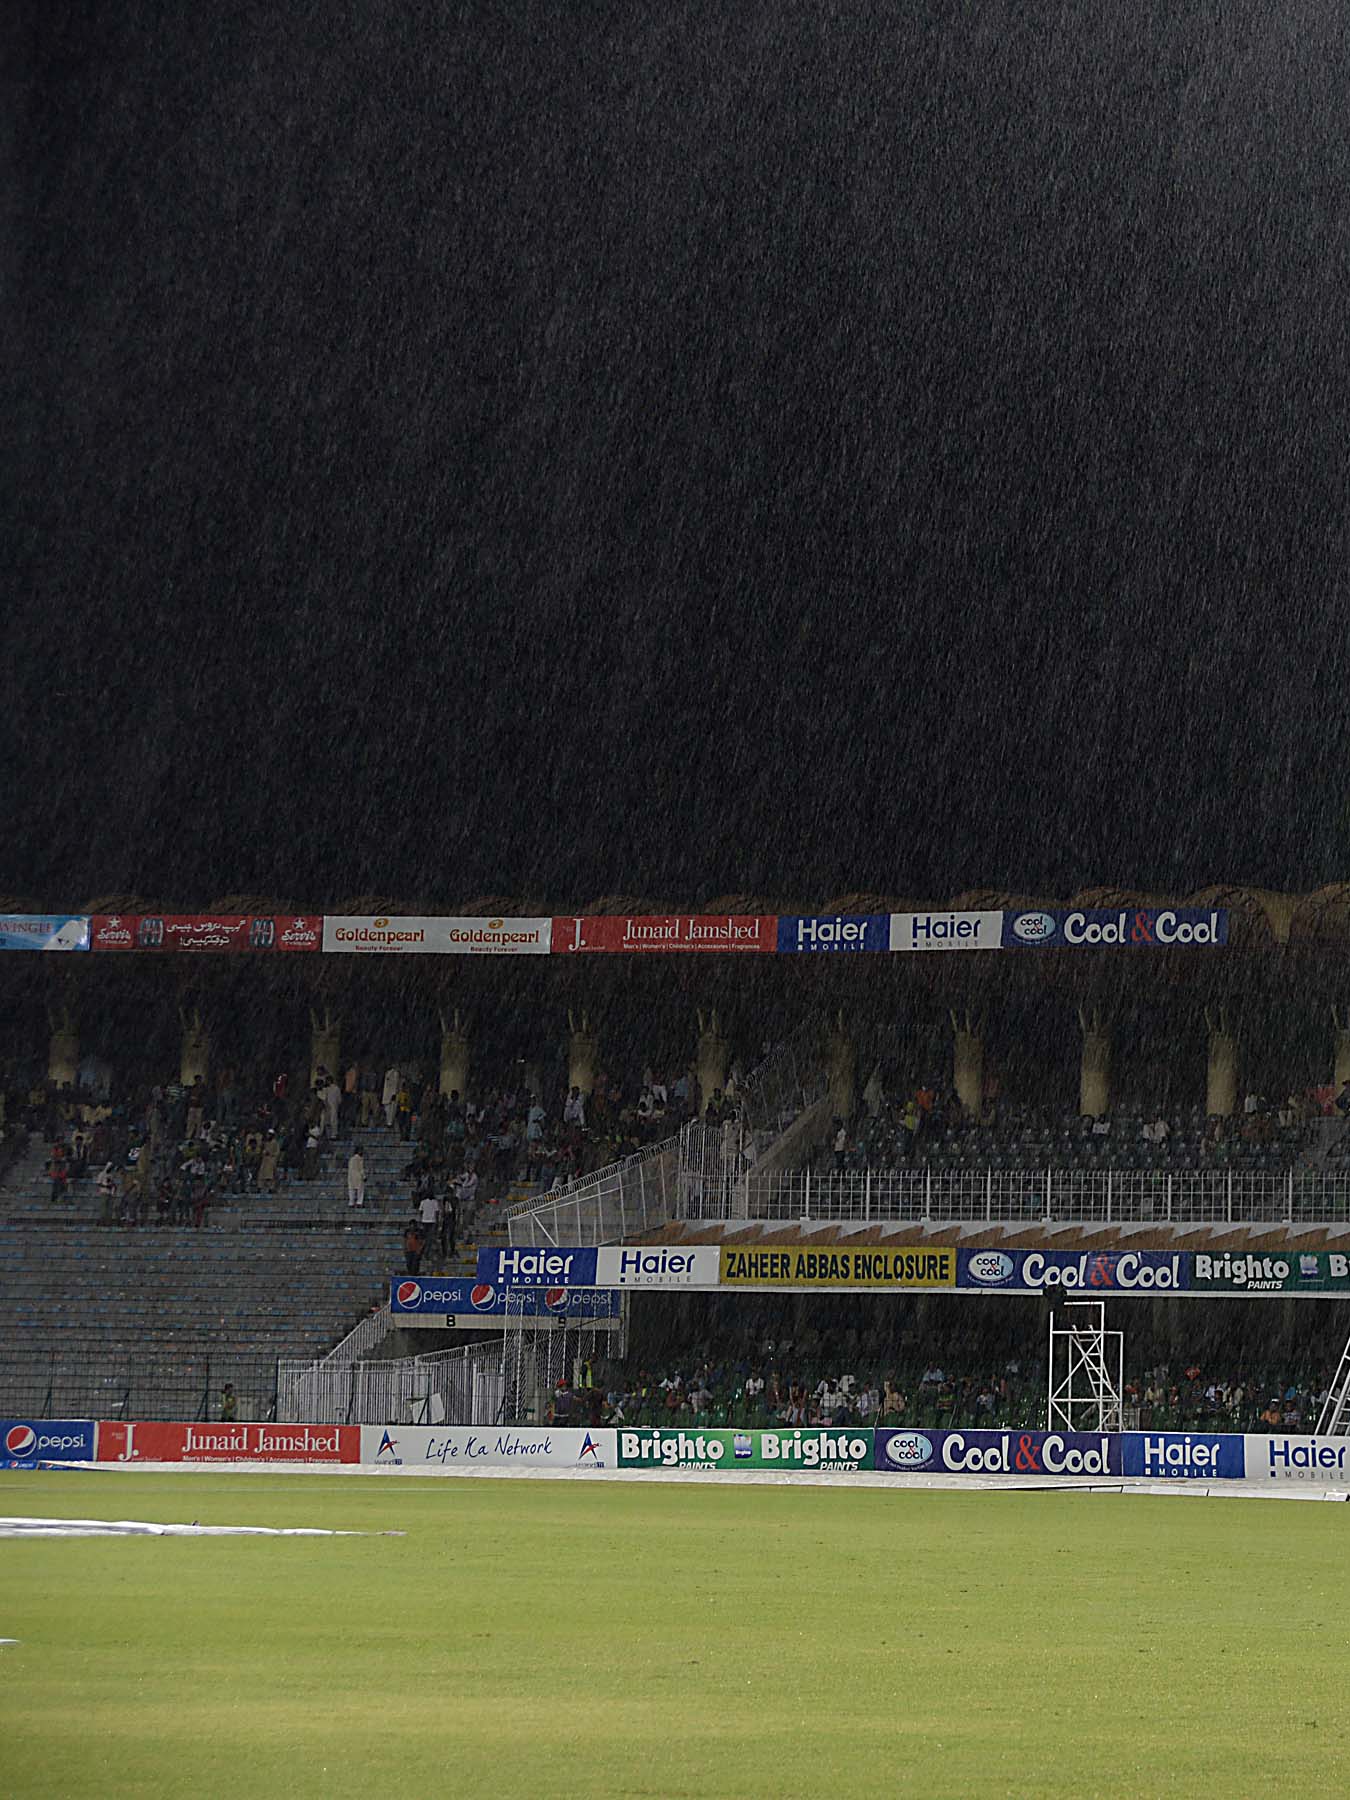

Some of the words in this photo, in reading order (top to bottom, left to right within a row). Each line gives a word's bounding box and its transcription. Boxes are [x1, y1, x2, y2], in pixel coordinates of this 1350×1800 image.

[335, 928, 424, 944] Goldenpearl
[450, 929, 539, 945] Goldenpearl
[623, 919, 679, 941] Junaid
[685, 919, 759, 941] Jamshed
[798, 917, 867, 941] Haier
[912, 915, 980, 938] Haier
[1065, 912, 1127, 944] Cool
[1132, 912, 1153, 941] &
[1156, 911, 1218, 943] Cool
[499, 1249, 573, 1274] Haier
[620, 1249, 695, 1274] Haier
[726, 1252, 791, 1280] ZAHEER
[795, 1252, 850, 1280] ABBAS
[854, 1253, 949, 1280] ENCLOSURE
[1023, 1253, 1088, 1288] Cool
[1091, 1255, 1115, 1286] &
[1116, 1253, 1179, 1289] Cool
[1195, 1252, 1289, 1284] Brighto
[423, 1289, 461, 1303] pepsi
[1247, 1280, 1283, 1289] PAINTS
[38, 1434, 85, 1451] pepsi
[182, 1427, 248, 1453] Junaid
[254, 1428, 340, 1453] Jamshed
[425, 1438, 459, 1463] Life
[464, 1436, 488, 1457] Ka
[494, 1434, 552, 1458] Network
[621, 1431, 725, 1465] Brighto
[761, 1430, 867, 1466] Brighto
[893, 1437, 919, 1448] cool
[898, 1448, 924, 1460] cool
[942, 1433, 1011, 1472] Cool
[1015, 1434, 1040, 1470] &
[1042, 1435, 1111, 1474] Cool
[1144, 1437, 1220, 1468] Haier
[1269, 1439, 1346, 1469] Haier
[679, 1462, 716, 1470] PAINTS
[820, 1462, 858, 1471] PAINTS
[1159, 1469, 1217, 1477] MOBILE
[1285, 1471, 1344, 1480] MOBILE
